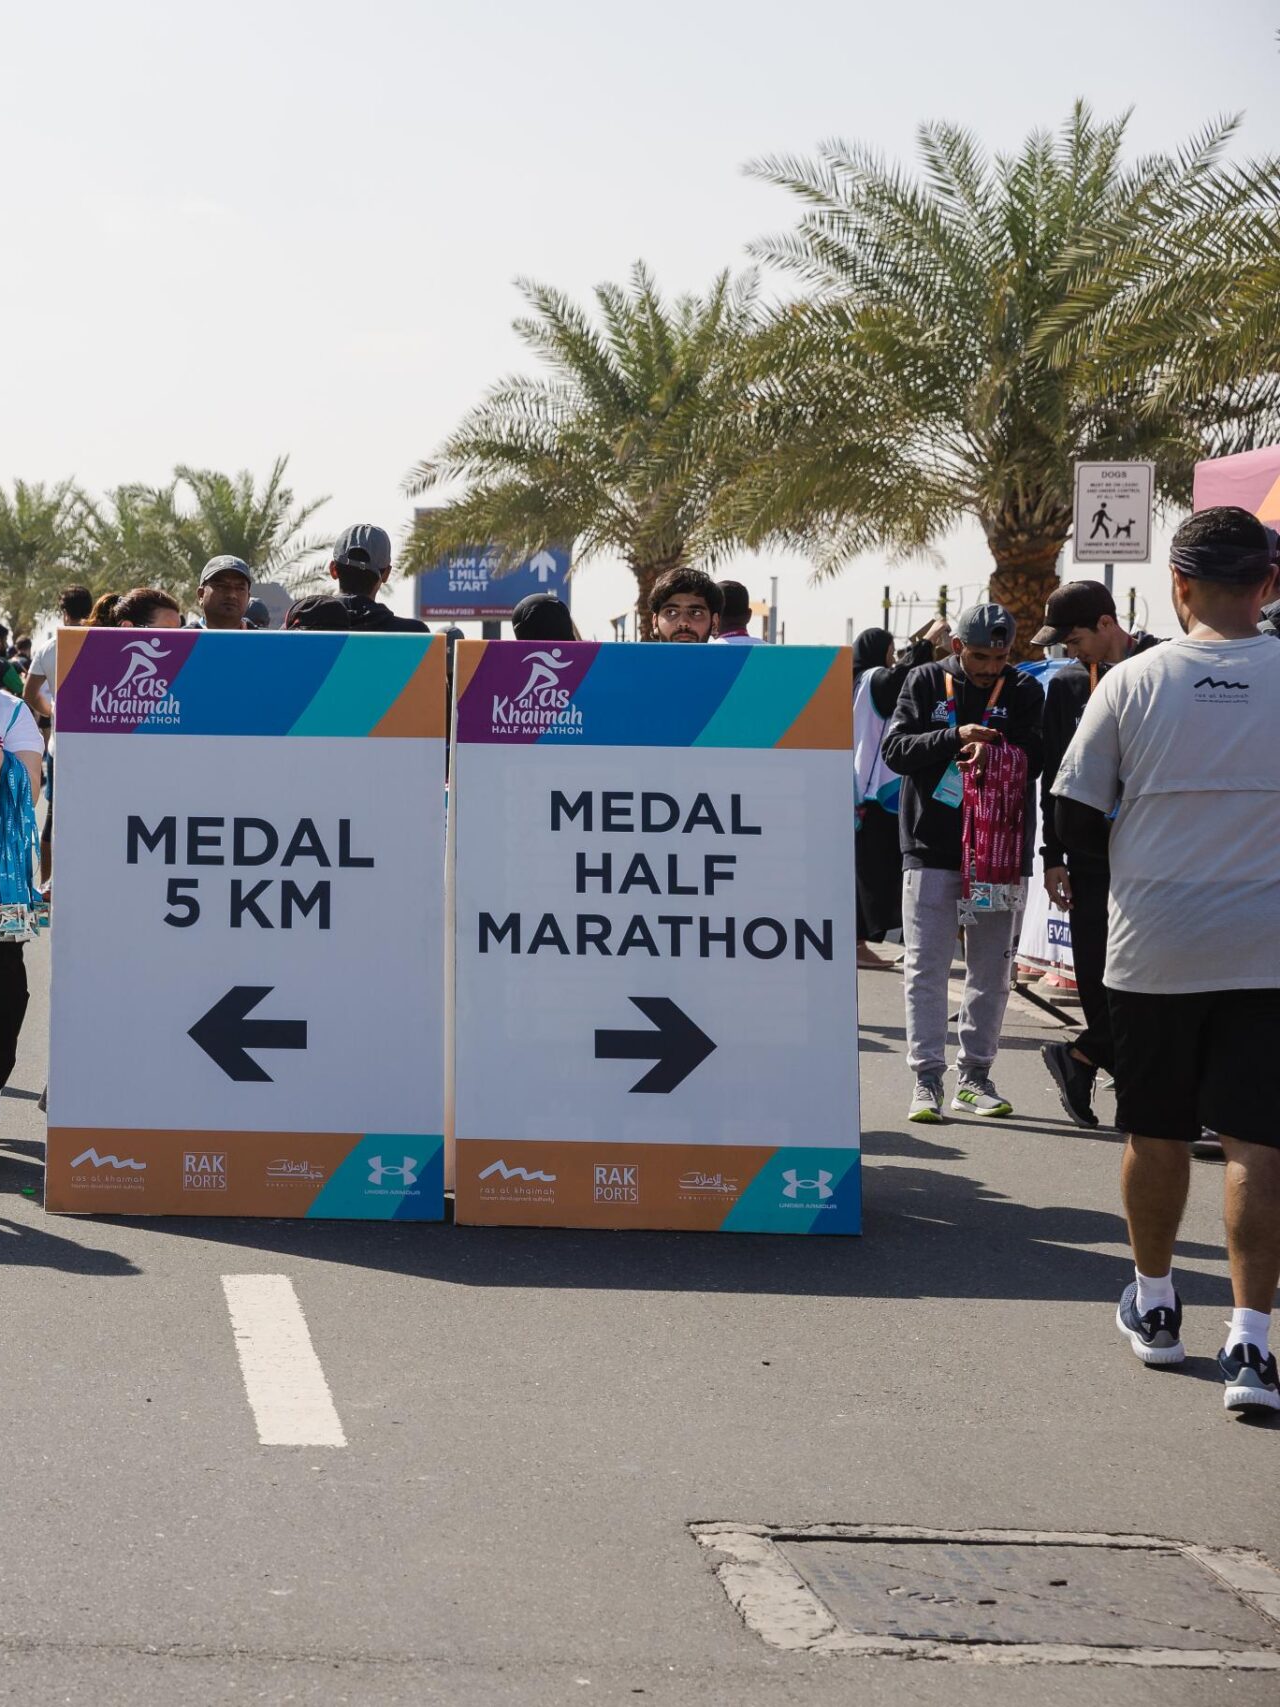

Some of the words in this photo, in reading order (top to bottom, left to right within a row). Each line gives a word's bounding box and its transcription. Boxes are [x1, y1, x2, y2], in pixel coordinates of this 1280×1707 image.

[448, 569, 454, 580] 1
[457, 569, 487, 580] MILE
[448, 581, 489, 592] START
[117, 683, 132, 698] al
[90, 684, 180, 715] Khaimah
[519, 693, 533, 708] al
[492, 694, 583, 726] Khaimah
[90, 715, 117, 724] HALF
[120, 715, 181, 725] MARATHON
[492, 725, 519, 734] HALF
[522, 726, 583, 735] MARATHON
[551, 790, 762, 836] MEDAL
[127, 815, 375, 869] MEDAL
[576, 852, 737, 896] HALF
[163, 878, 201, 929] 5
[230, 879, 331, 930] KM
[479, 911, 834, 961] MARATHON
[184, 1154, 225, 1173] RAK
[91, 1175, 101, 1183] al
[105, 1175, 145, 1184] khaimah
[184, 1174, 225, 1188] PORTS
[595, 1166, 636, 1185] RAK
[514, 1187, 555, 1195] khaimah
[595, 1187, 637, 1201] PORTS
